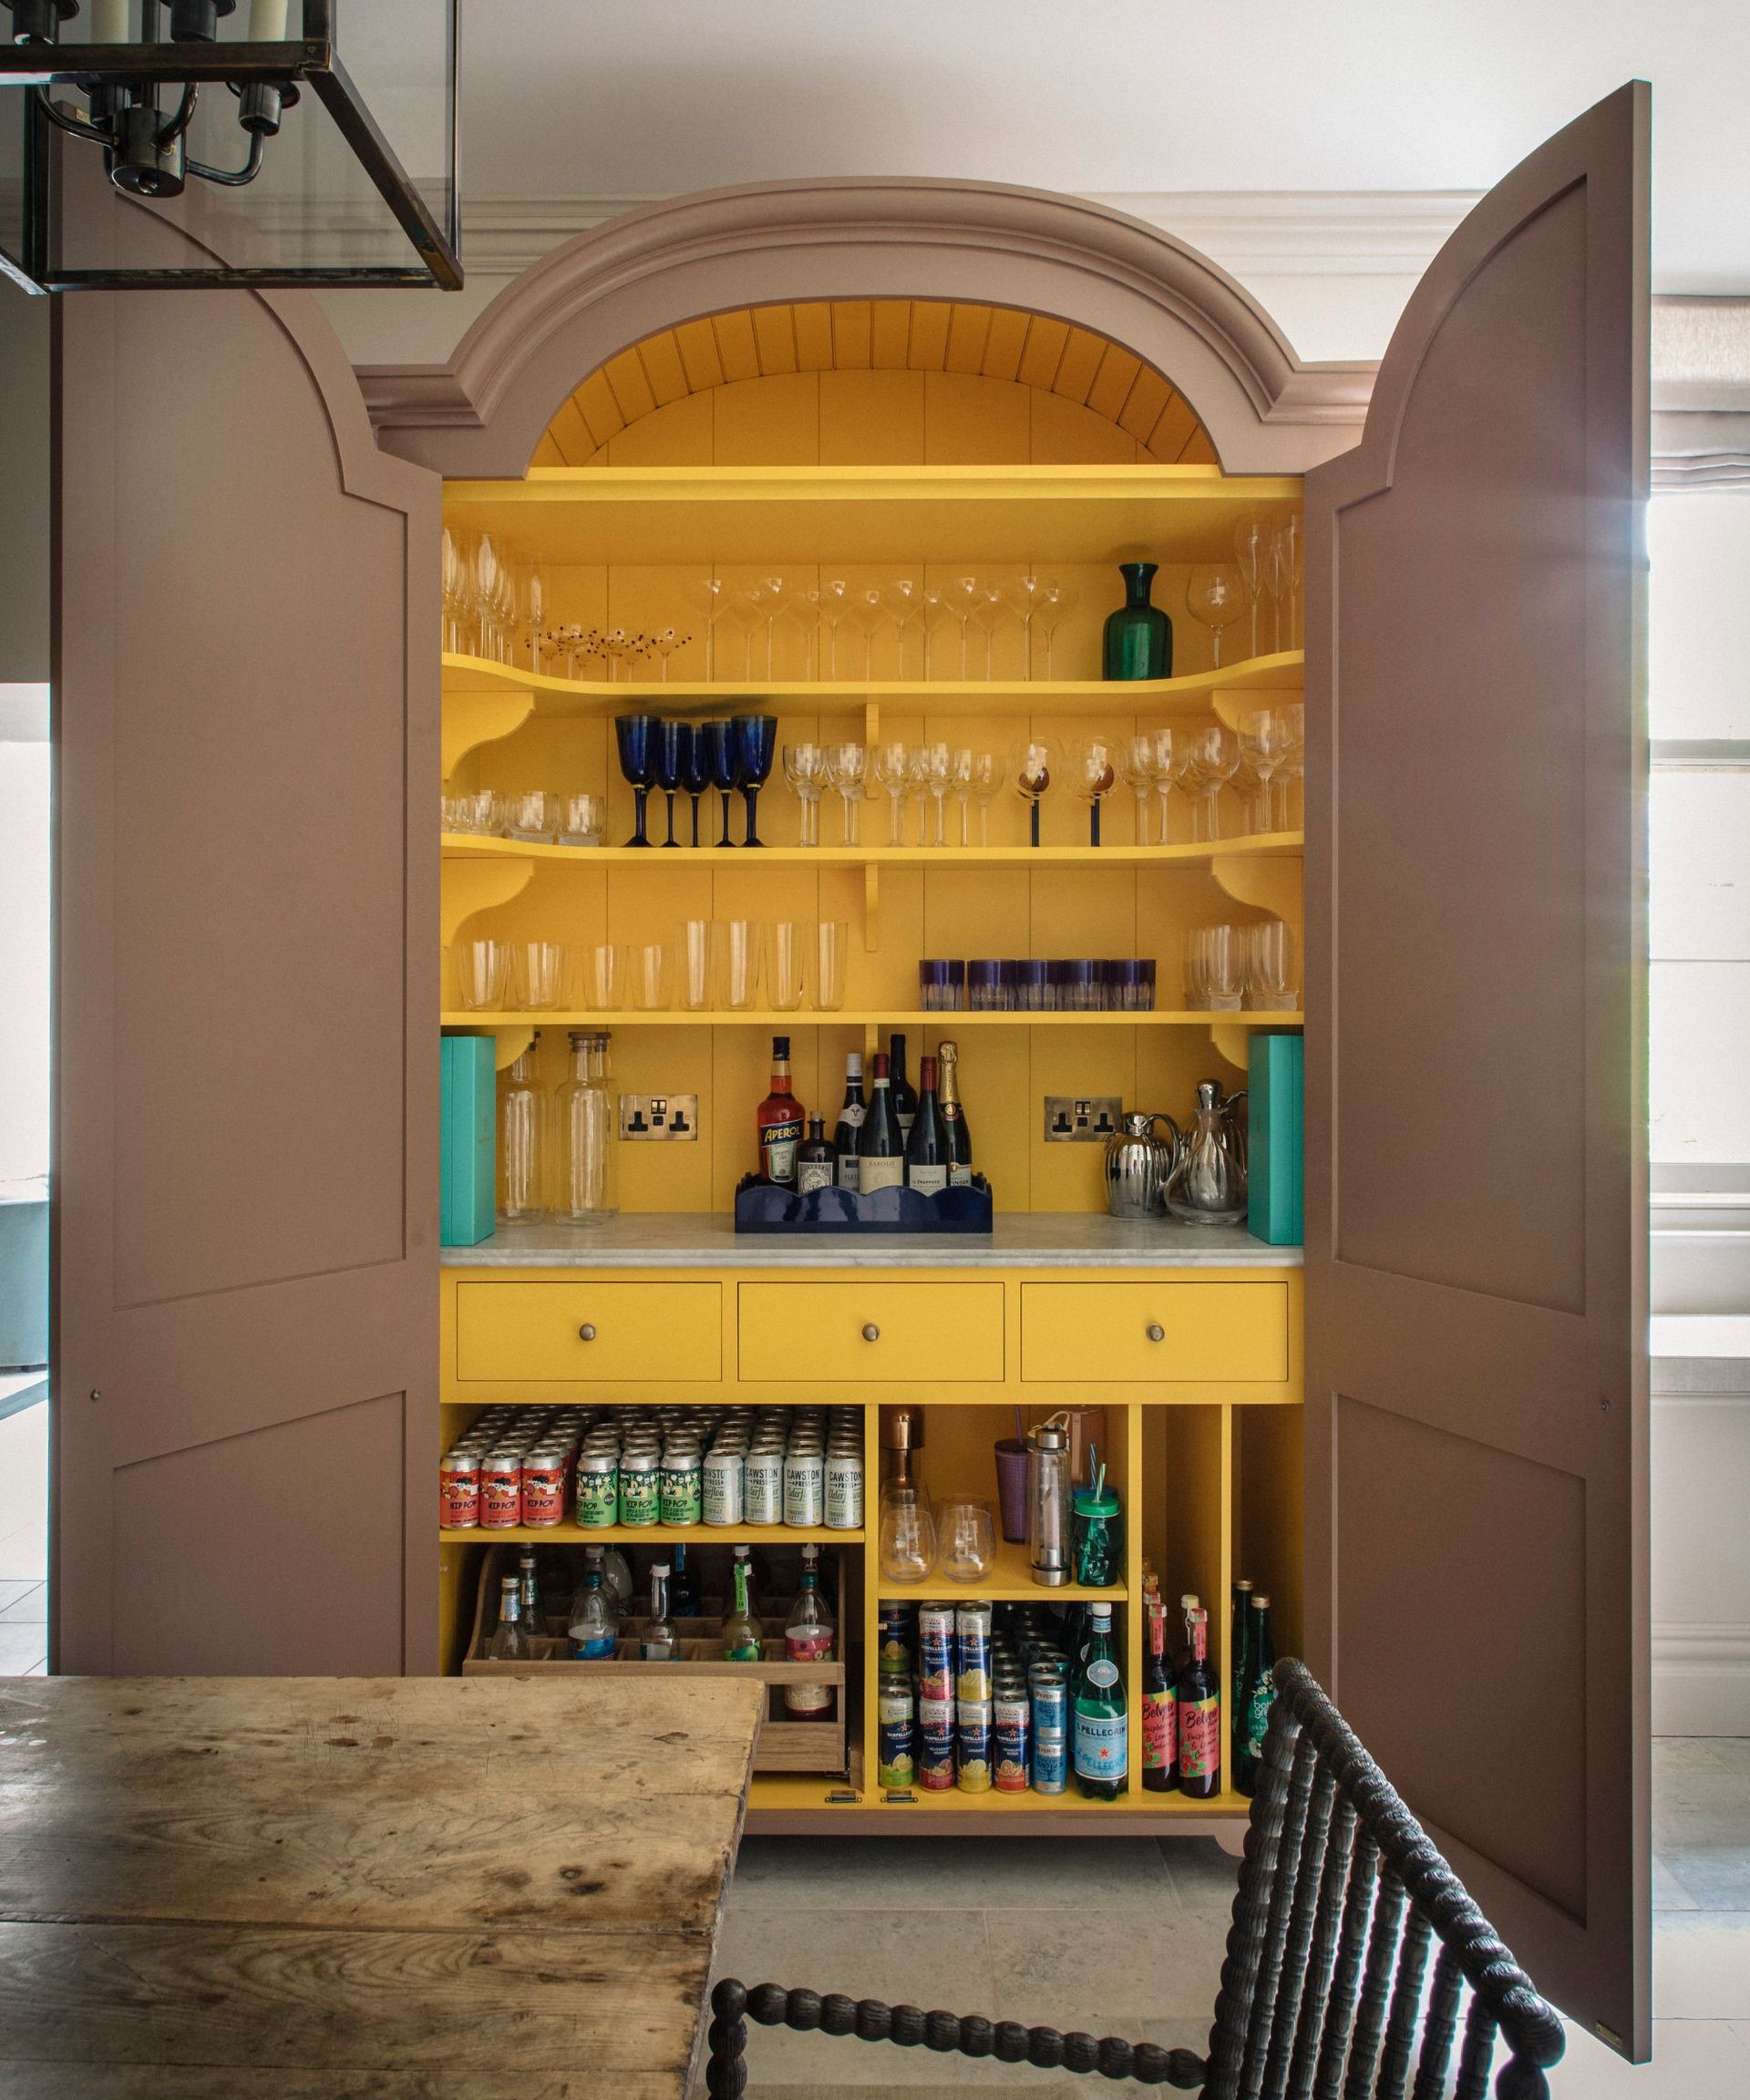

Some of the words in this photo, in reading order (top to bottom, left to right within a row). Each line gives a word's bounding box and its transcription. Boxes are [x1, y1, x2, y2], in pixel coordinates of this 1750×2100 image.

[764, 1126, 799, 1143] APEROL
[787, 1468, 820, 1480] CAWSTON
[829, 1471, 862, 1482] CAWSTON
[449, 1501, 463, 1509] HIP
[463, 1499, 477, 1508] POP
[488, 1500, 499, 1509] HIP
[500, 1500, 516, 1509] POP
[527, 1499, 539, 1508] HIP
[539, 1499, 554, 1508] POP
[583, 1502, 598, 1510] POP
[626, 1500, 638, 1508] HIP
[638, 1500, 653, 1508] POP
[673, 1499, 688, 1508] POP
